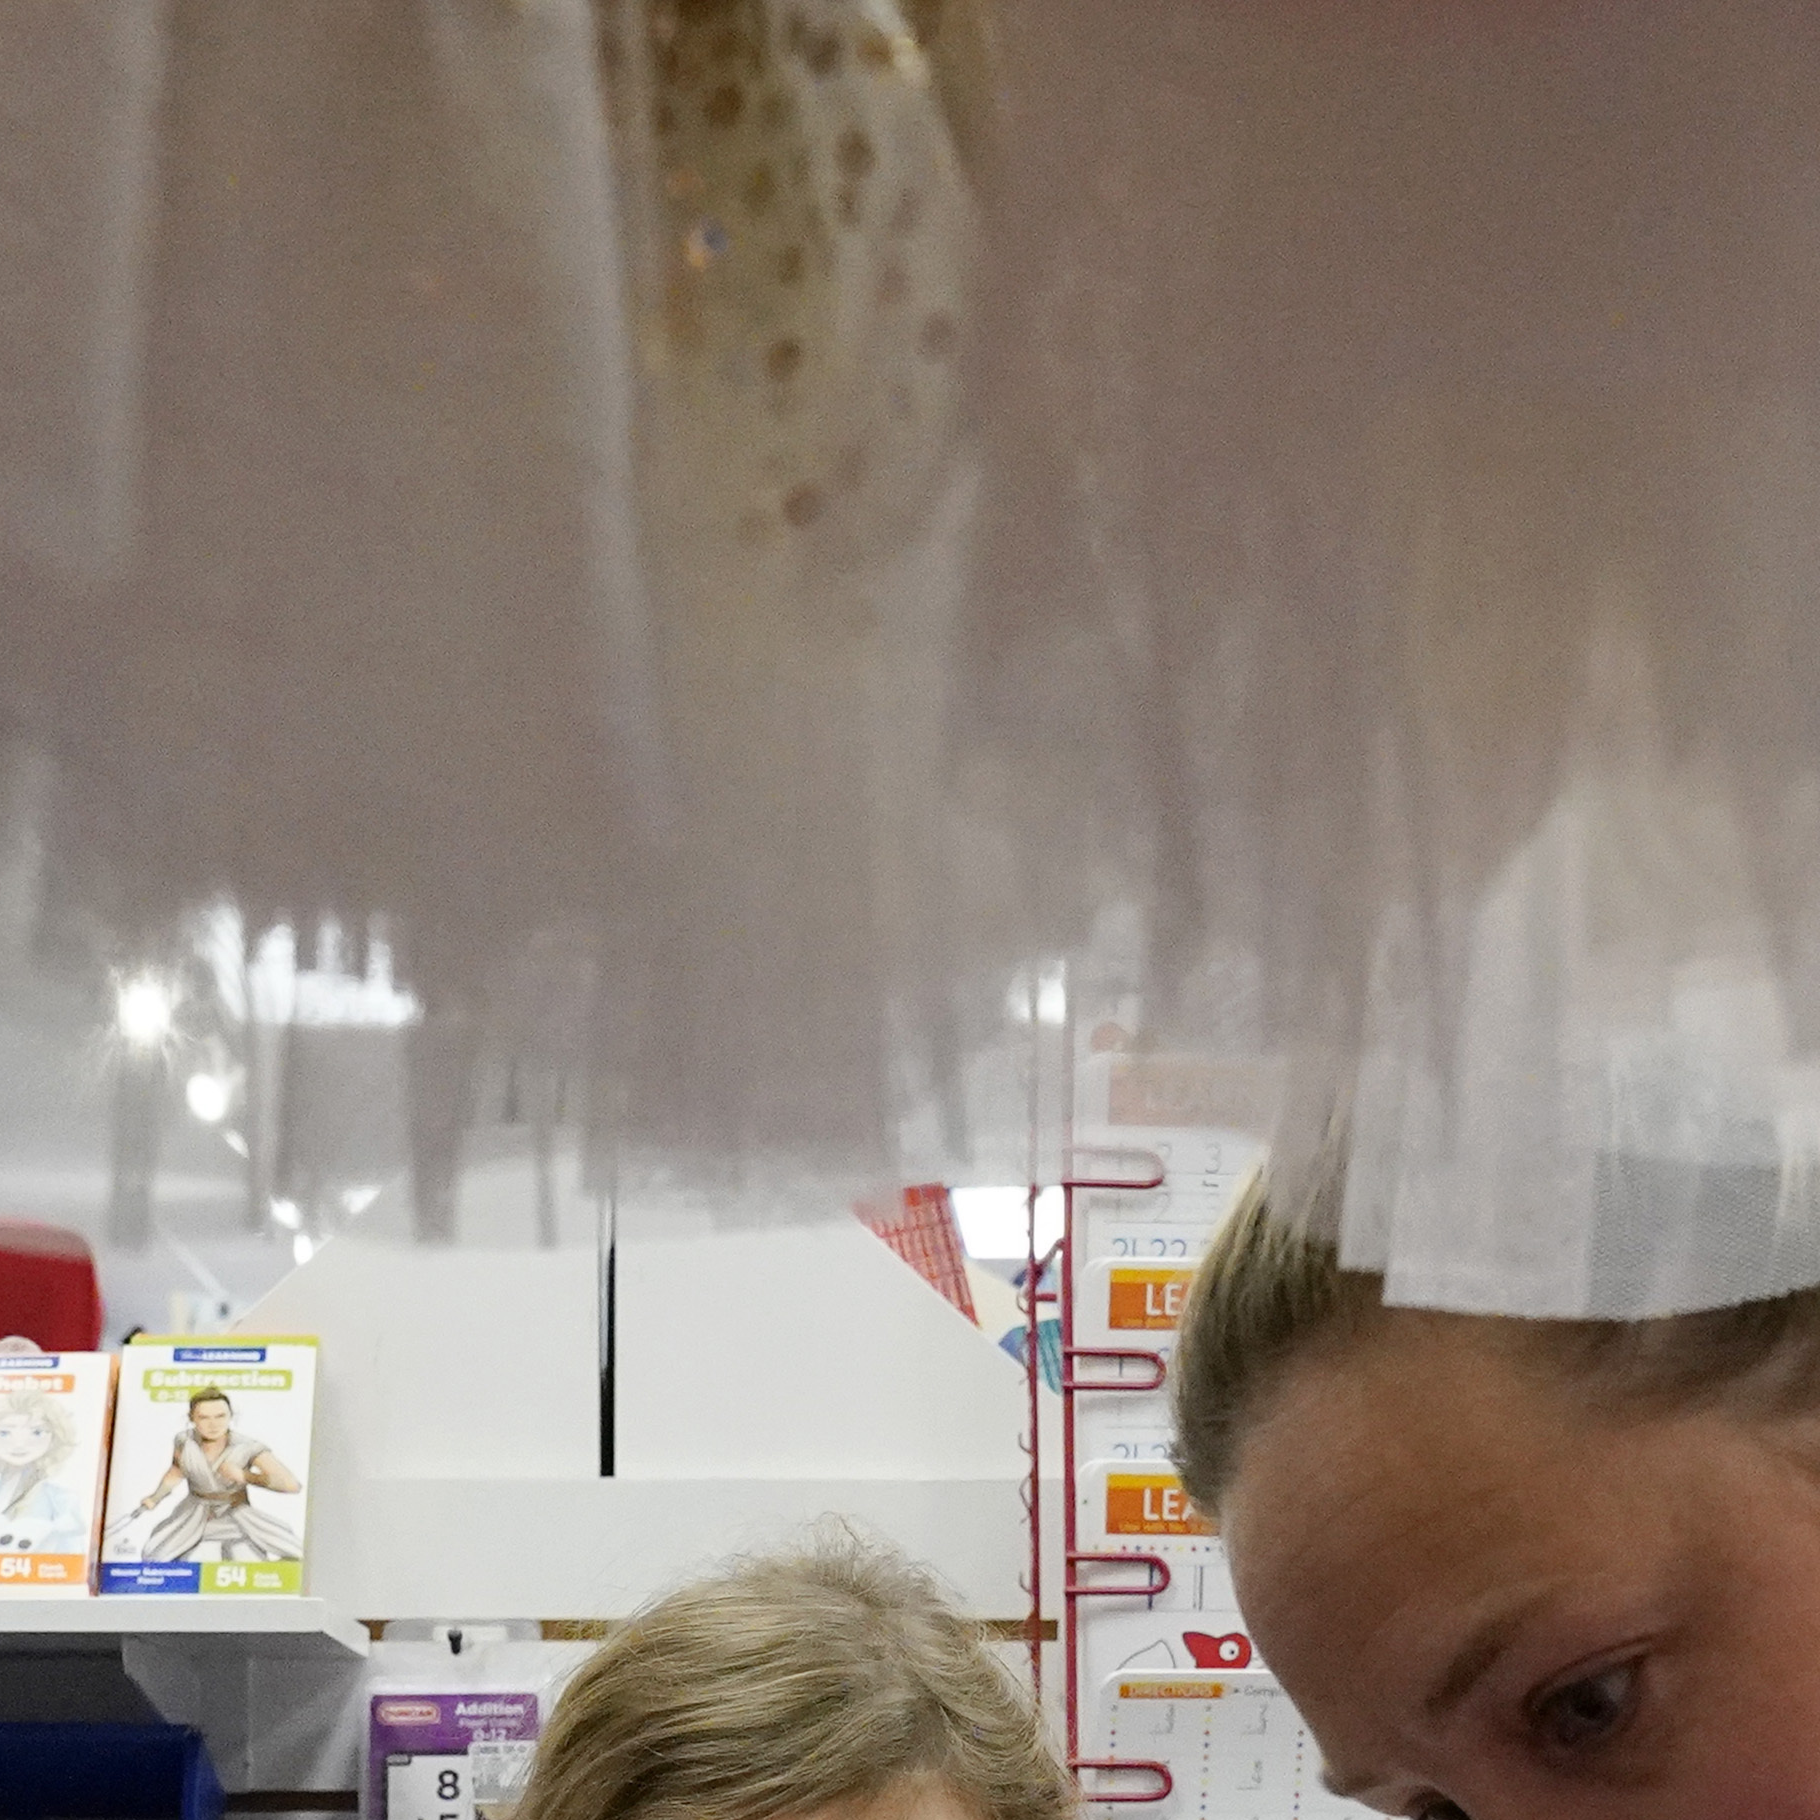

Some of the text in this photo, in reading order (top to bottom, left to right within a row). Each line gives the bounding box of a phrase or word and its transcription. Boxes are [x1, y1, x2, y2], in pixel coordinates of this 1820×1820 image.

[149, 1369, 286, 1390] Subtraction
[0, 1557, 32, 1579] 54
[215, 1565, 247, 1588] 54
[454, 1701, 524, 1717] Addition
[436, 1769, 461, 1801] 8
